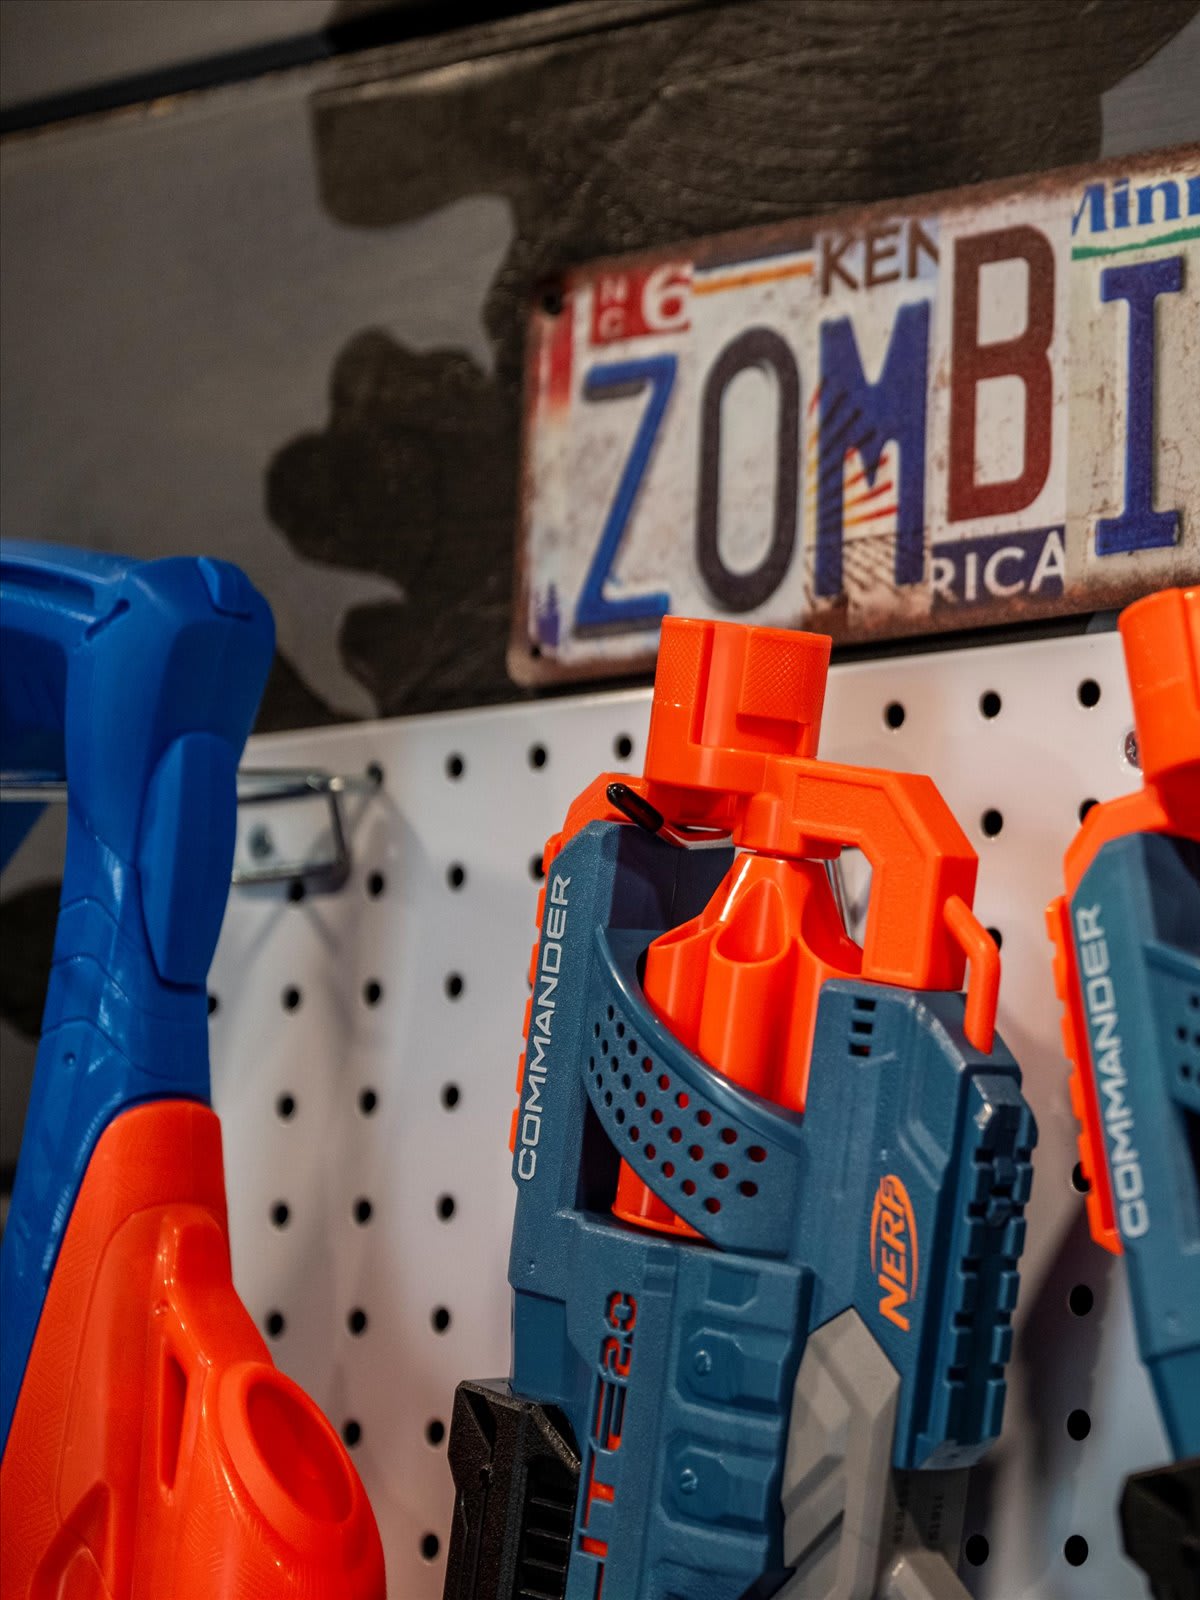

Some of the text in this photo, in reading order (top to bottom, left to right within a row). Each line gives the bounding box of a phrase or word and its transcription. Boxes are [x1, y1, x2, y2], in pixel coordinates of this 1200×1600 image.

[641, 260, 693, 334] 6
[930, 529, 1065, 604] RICA
[516, 873, 572, 1181] COMMANDER
[1075, 902, 1151, 1240] COMMANDER
[877, 1175, 912, 1333] NERF
